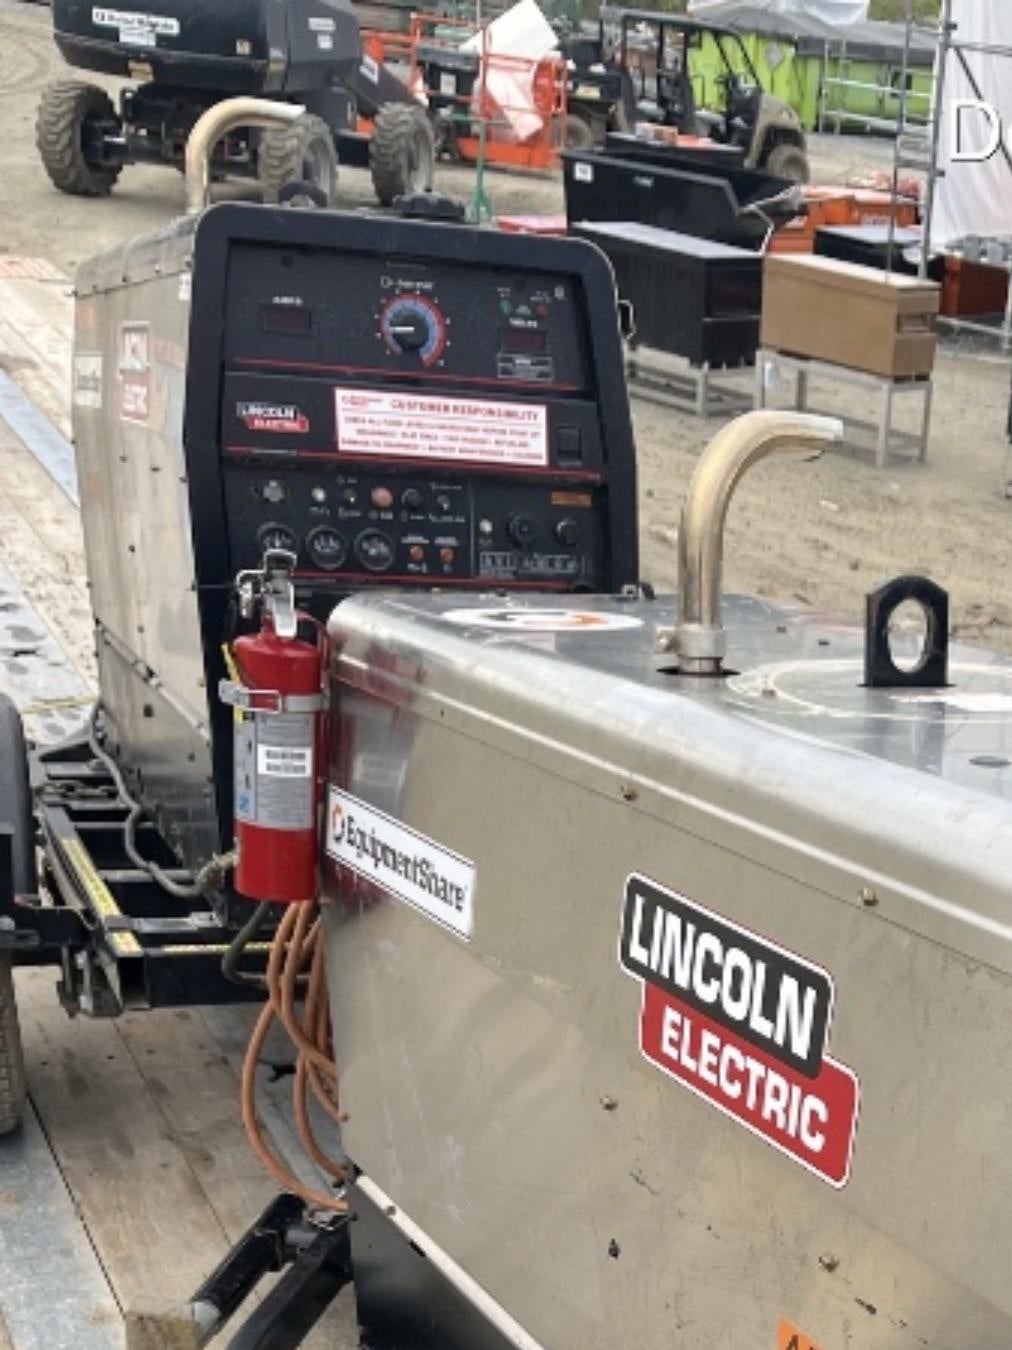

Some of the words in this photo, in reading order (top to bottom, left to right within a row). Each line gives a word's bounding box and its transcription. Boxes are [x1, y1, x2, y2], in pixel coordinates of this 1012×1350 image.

[346, 815, 466, 913] EquipmentShare
[628, 893, 818, 1062] LINCOLN
[661, 1005, 829, 1153] ELECTRIC
